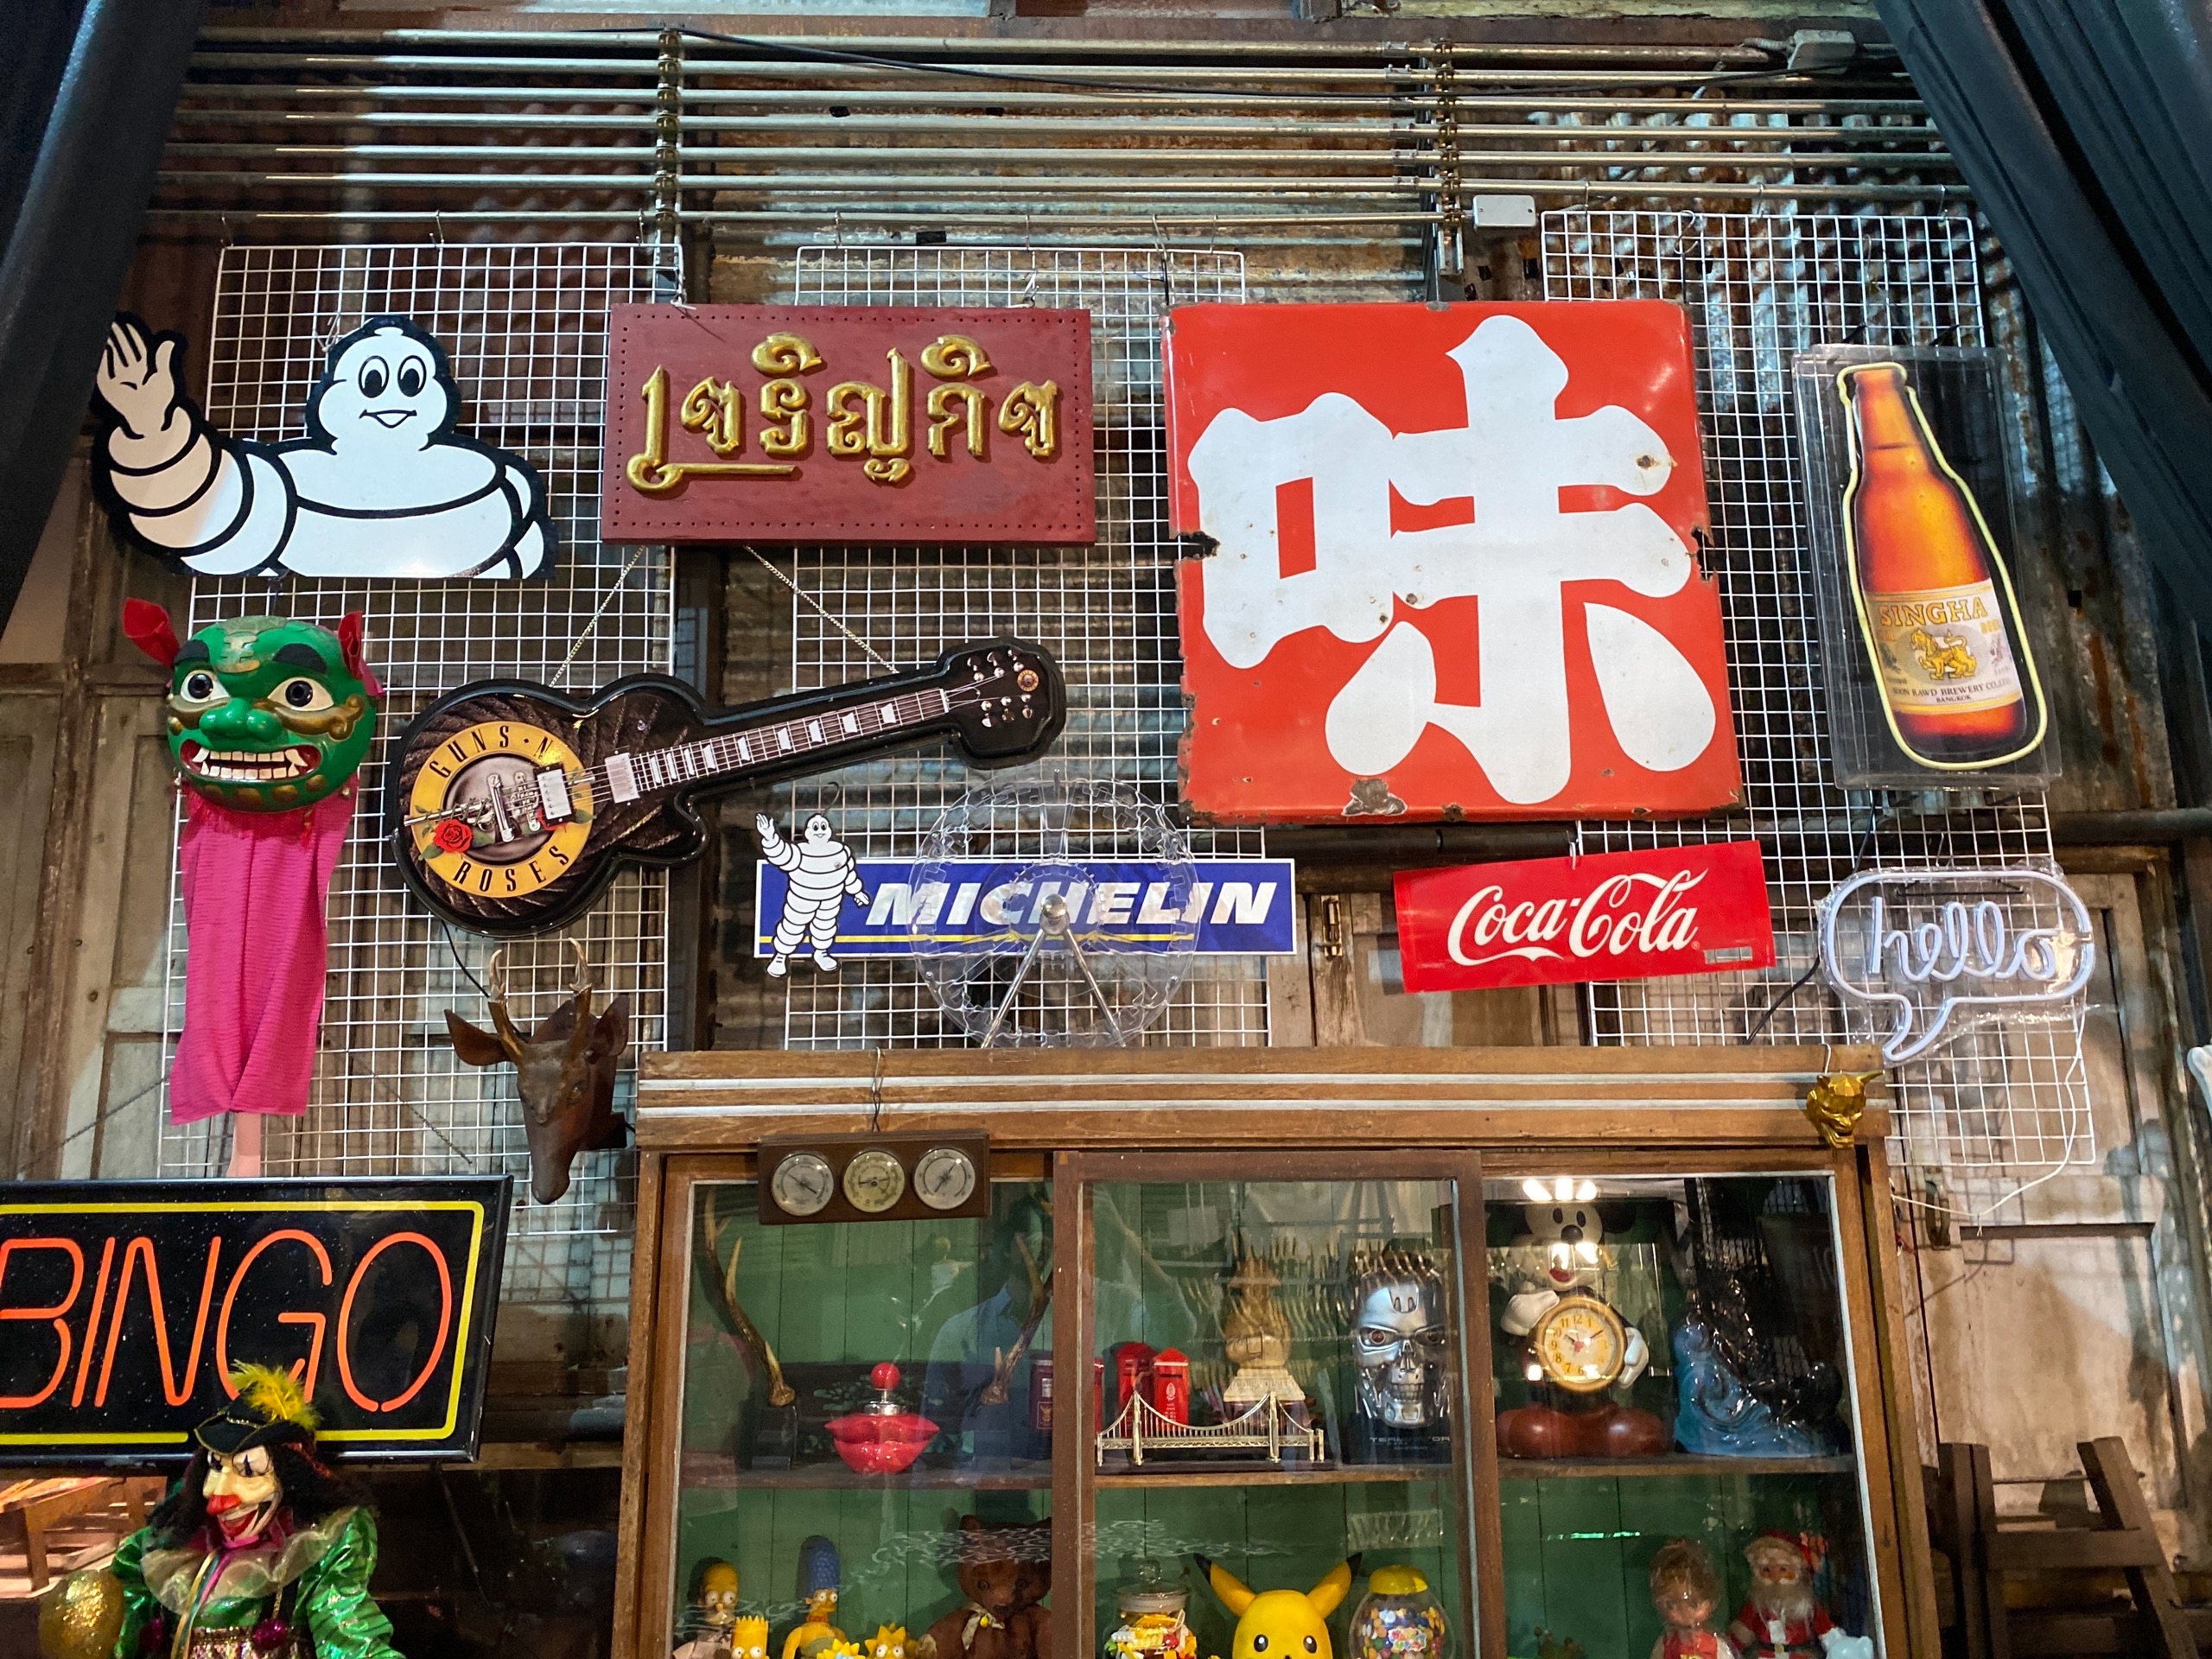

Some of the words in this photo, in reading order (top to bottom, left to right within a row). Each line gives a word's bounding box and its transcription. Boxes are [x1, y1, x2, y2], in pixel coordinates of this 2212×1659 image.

[1187, 315, 1717, 804] 味
[1878, 596, 1988, 626] SINGHA
[1912, 688, 1937, 696] RAWD
[1940, 683, 1984, 696] BREWERY
[1936, 695, 1972, 703] BANGKOK
[429, 725, 510, 779] GUNS
[453, 845, 569, 893] ROSES
[865, 881, 1278, 925] MICHELIN
[1446, 866, 1708, 967] Coca-Cola
[1868, 895, 2063, 982] hello
[0, 1229, 452, 1412] BINGO
[1560, 1318, 1569, 1328] 11
[1573, 1314, 1582, 1324] 12
[1551, 1340, 1557, 1350] 9
[1555, 1353, 1562, 1363] 8
[1565, 1363, 1572, 1373] 7
[1578, 1366, 1585, 1376] 6
